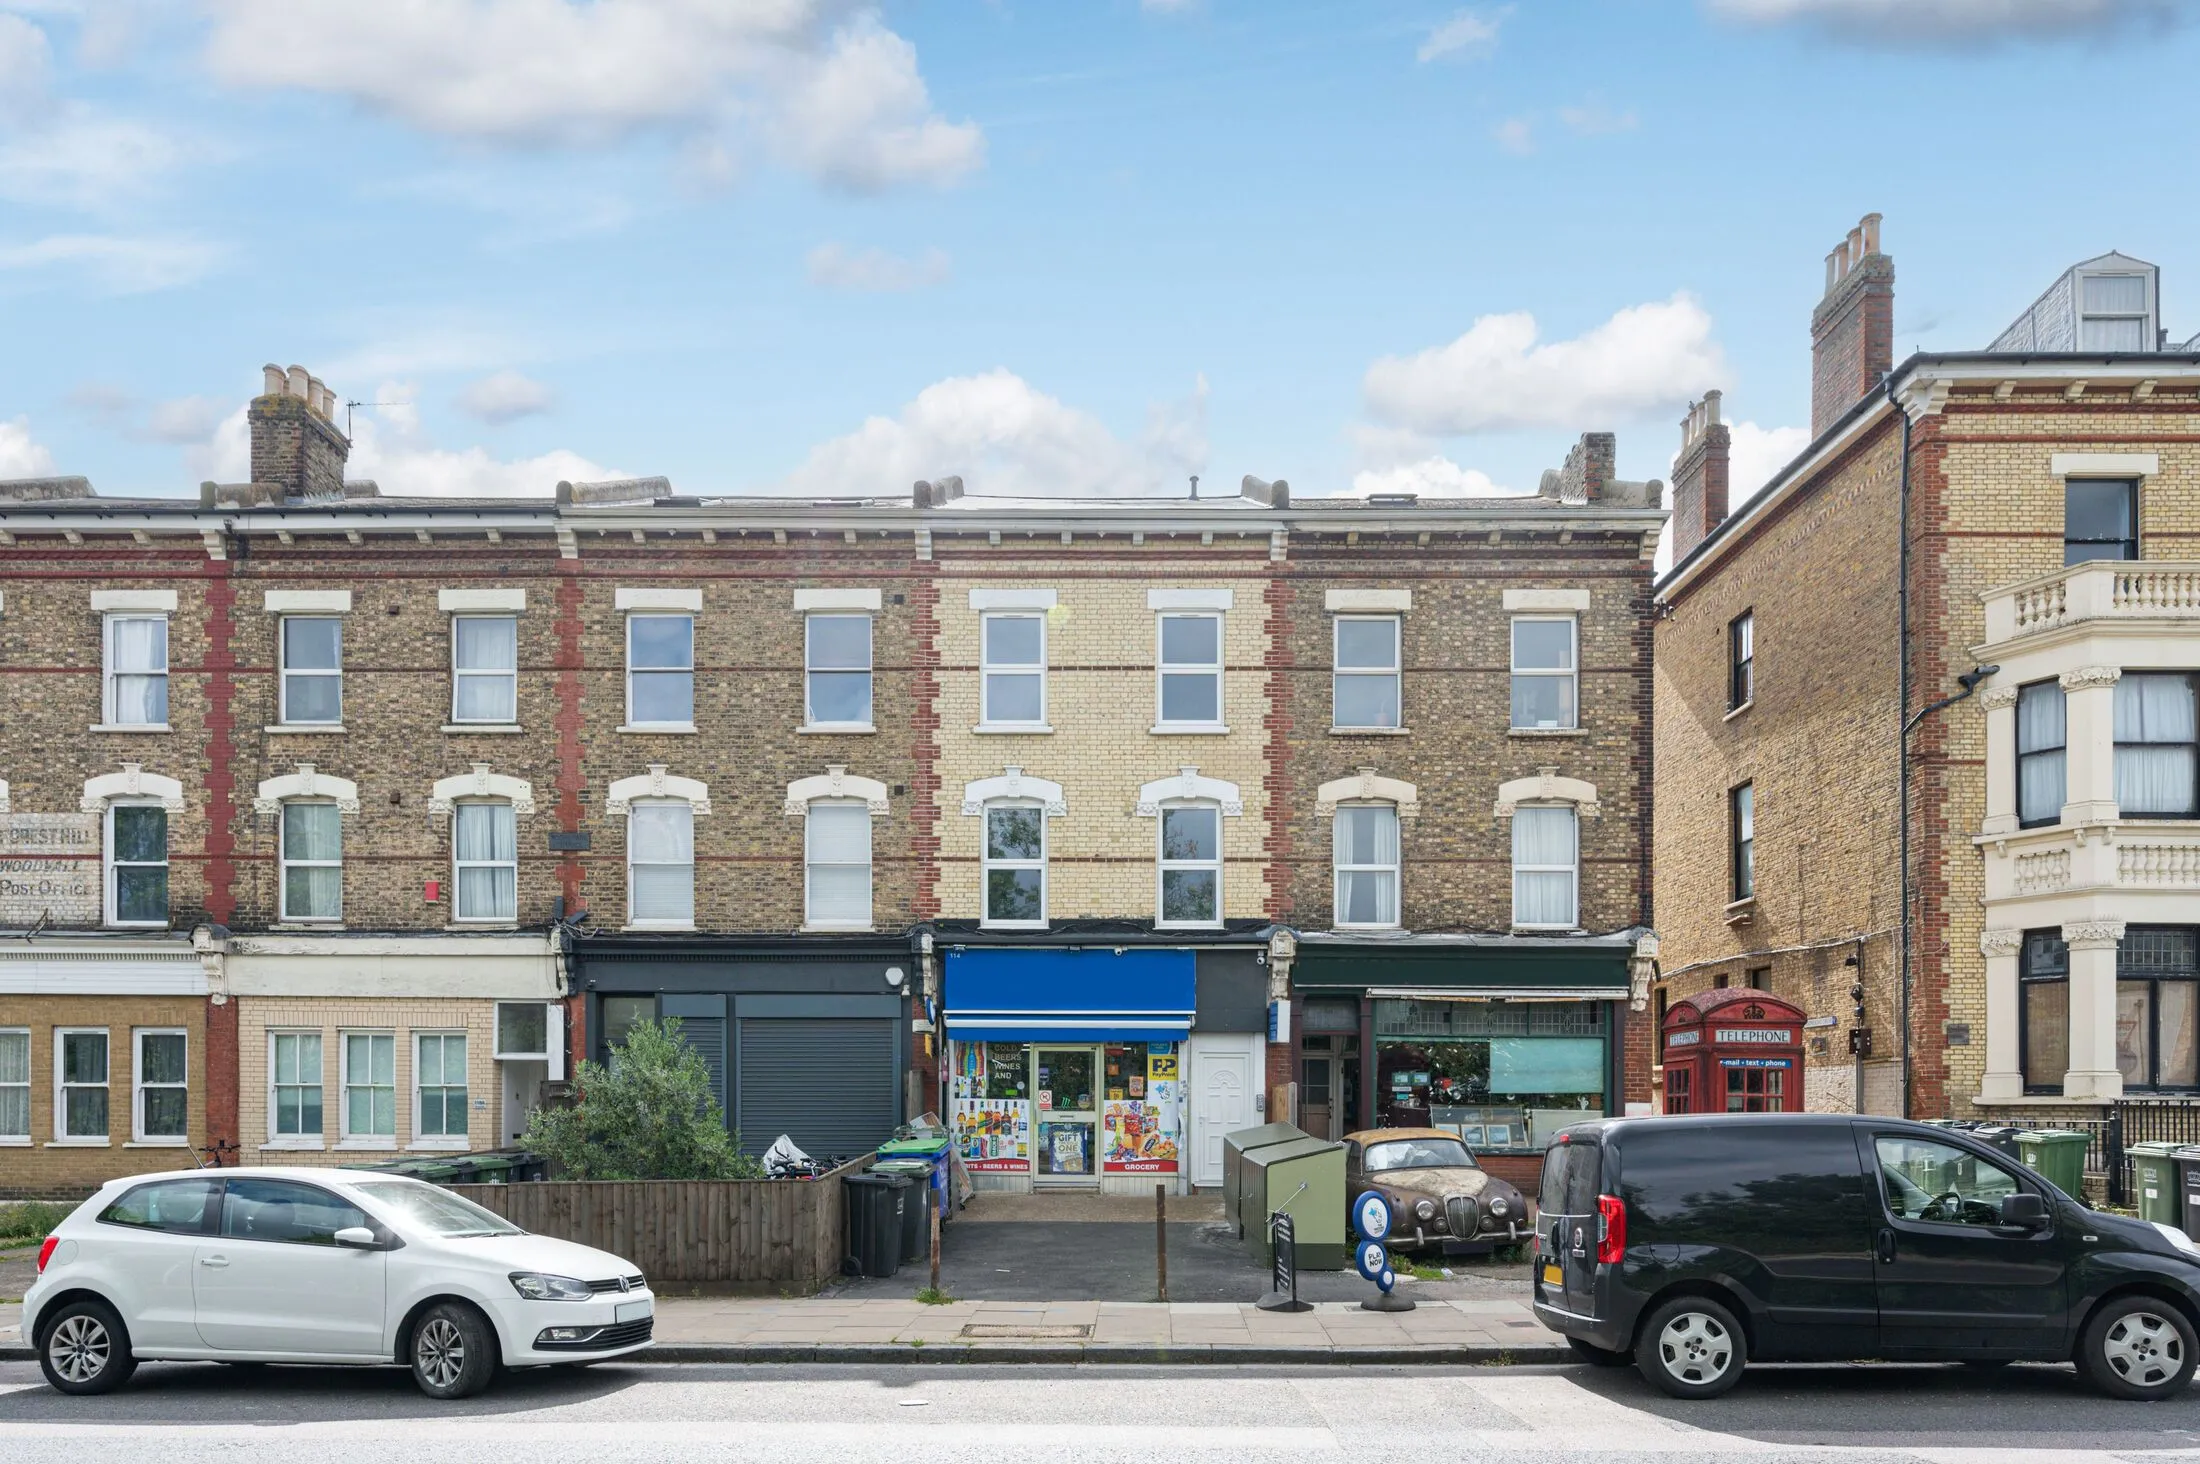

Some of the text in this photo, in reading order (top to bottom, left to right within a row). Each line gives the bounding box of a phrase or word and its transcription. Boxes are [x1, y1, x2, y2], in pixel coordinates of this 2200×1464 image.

[1719, 1030, 1788, 1042] TELEPHONE
[994, 1044, 1017, 1052] COLD
[994, 1053, 1022, 1061] BEERS
[1765, 1059, 1786, 1067] phone
[1058, 1133, 1079, 1142] GIFT
[1058, 1144, 1079, 1152] ONE
